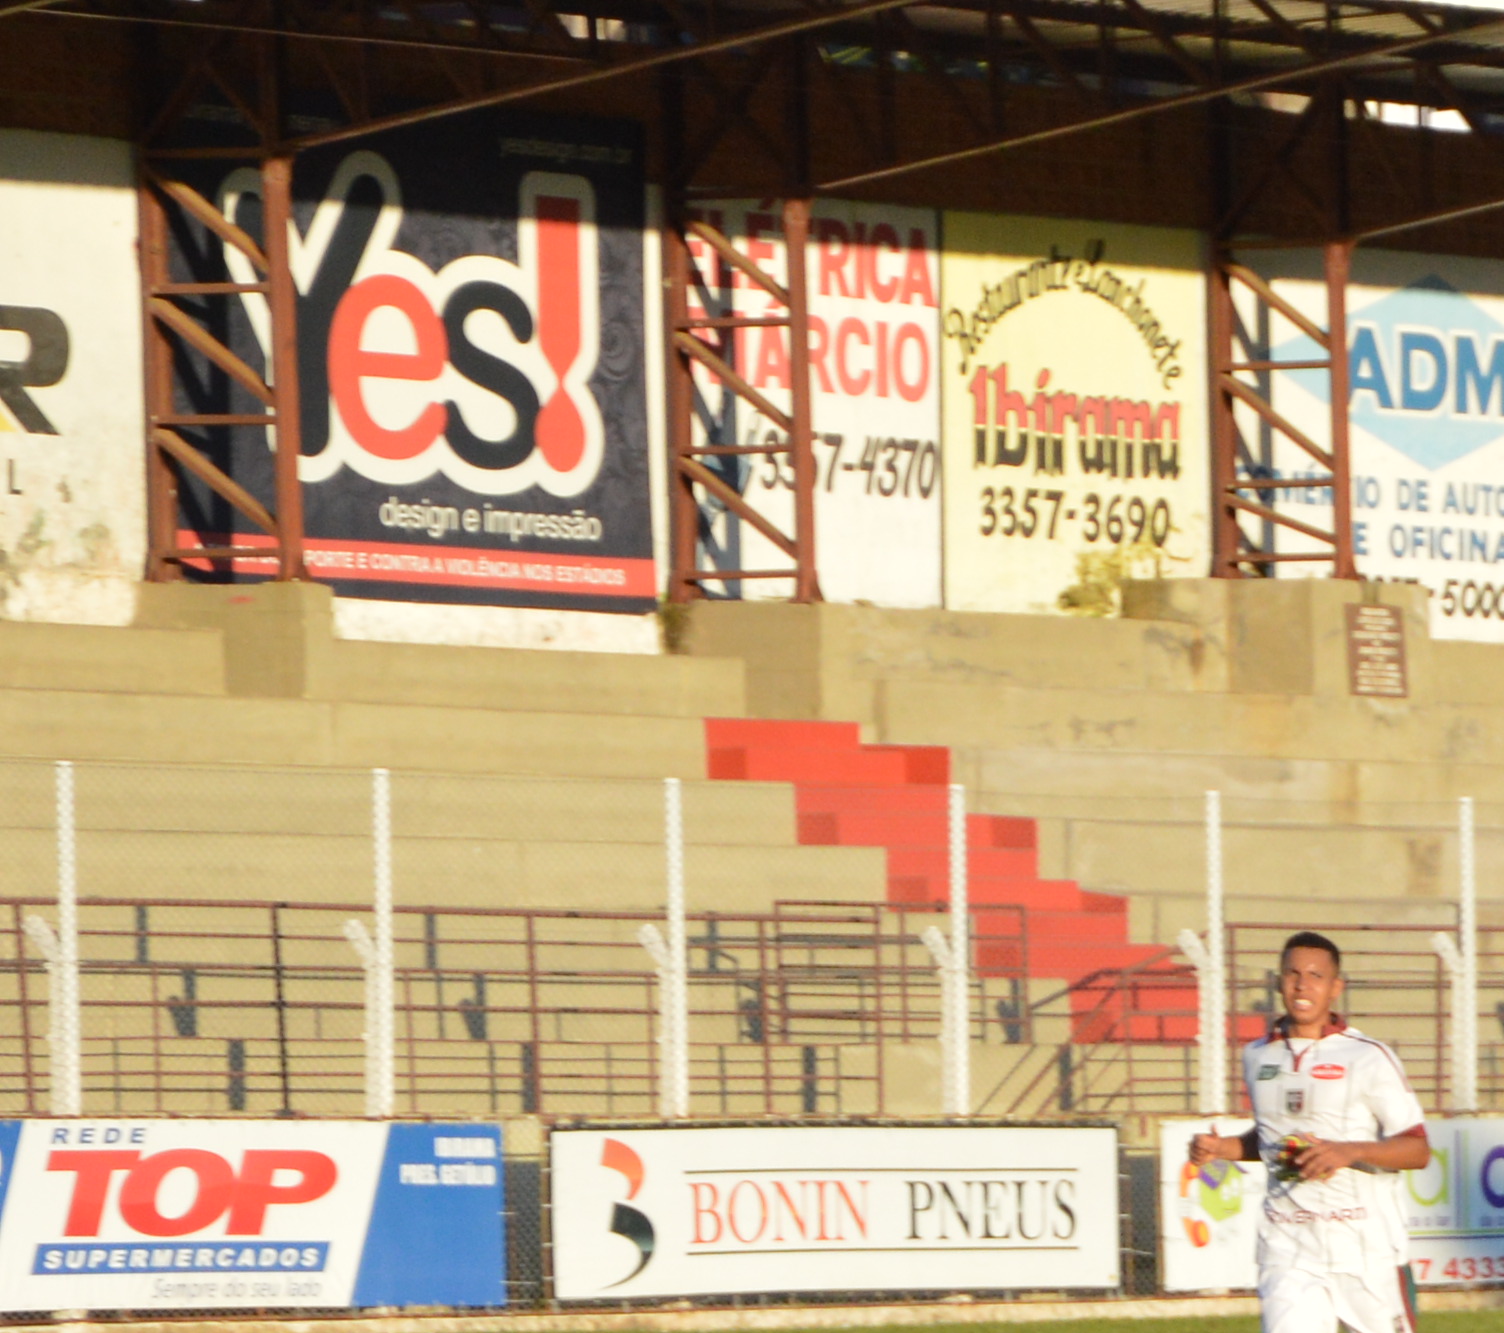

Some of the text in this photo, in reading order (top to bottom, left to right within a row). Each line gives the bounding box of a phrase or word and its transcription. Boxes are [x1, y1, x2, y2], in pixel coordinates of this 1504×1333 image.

[685, 197, 939, 309] ELÉRICA
[224, 158, 594, 478] Yes!
[969, 362, 1181, 482] Ibirama
[760, 428, 937, 499] 337-4370
[1397, 478, 1430, 513] DE
[379, 497, 603, 543] design e impressão
[980, 485, 1172, 549] 3357-3690
[371, 553, 432, 574] CONTRA
[446, 557, 520, 581] VIOLÊNCIA
[523, 563, 553, 581] NOS
[51, 1126, 147, 1145] REDE
[46, 1148, 339, 1237] TOP
[689, 1178, 1079, 1245] BONIN PNEUS
[43, 1246, 320, 1271] SUPERMERCADOS
